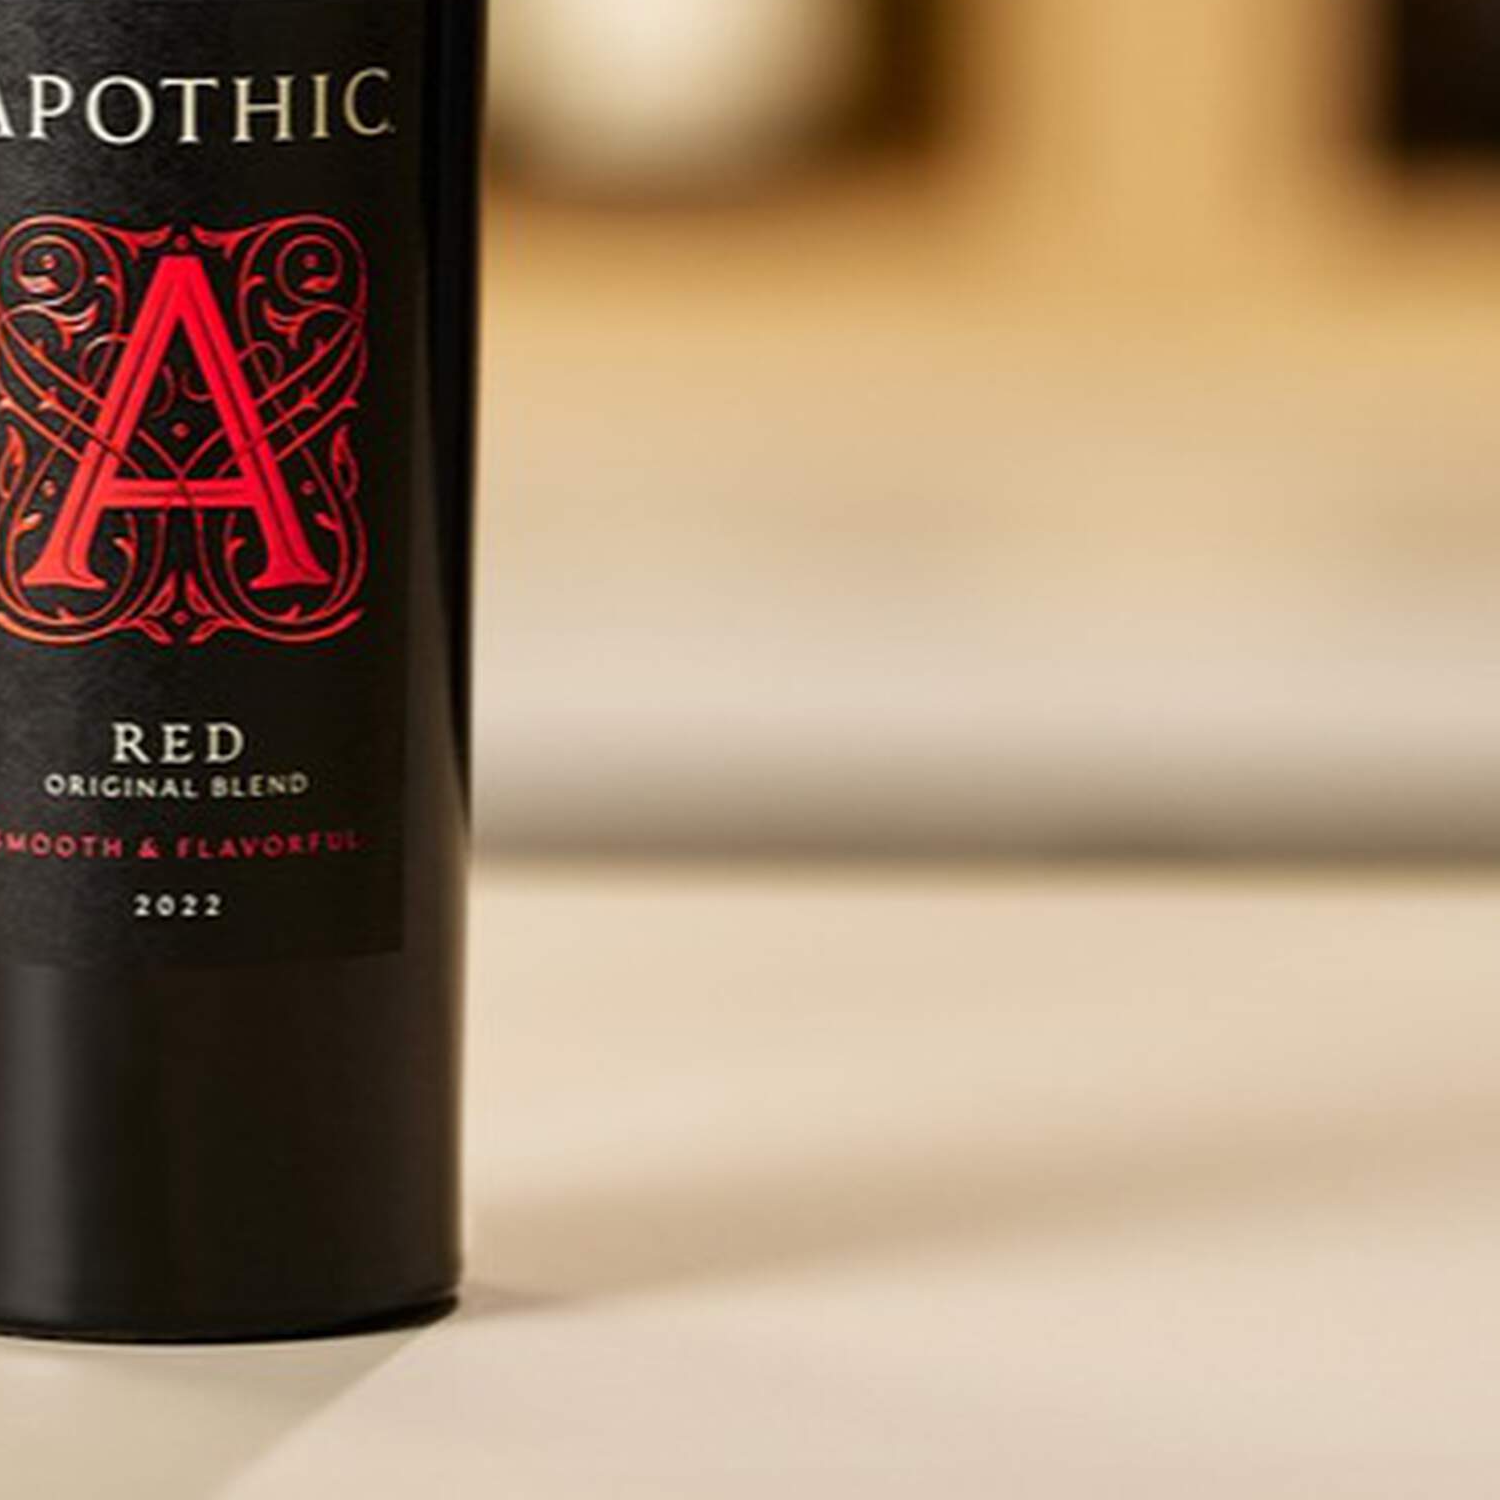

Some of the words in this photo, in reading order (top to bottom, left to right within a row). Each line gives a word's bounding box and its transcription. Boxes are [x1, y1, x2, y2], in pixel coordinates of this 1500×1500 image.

[21, 255, 332, 589] A
[111, 721, 245, 764] RED
[43, 773, 200, 799] ORIGINAL
[210, 772, 309, 798] BLEND
[137, 835, 160, 859] &
[177, 830, 361, 859] FLAVORFUL
[134, 893, 222, 918] 2022
